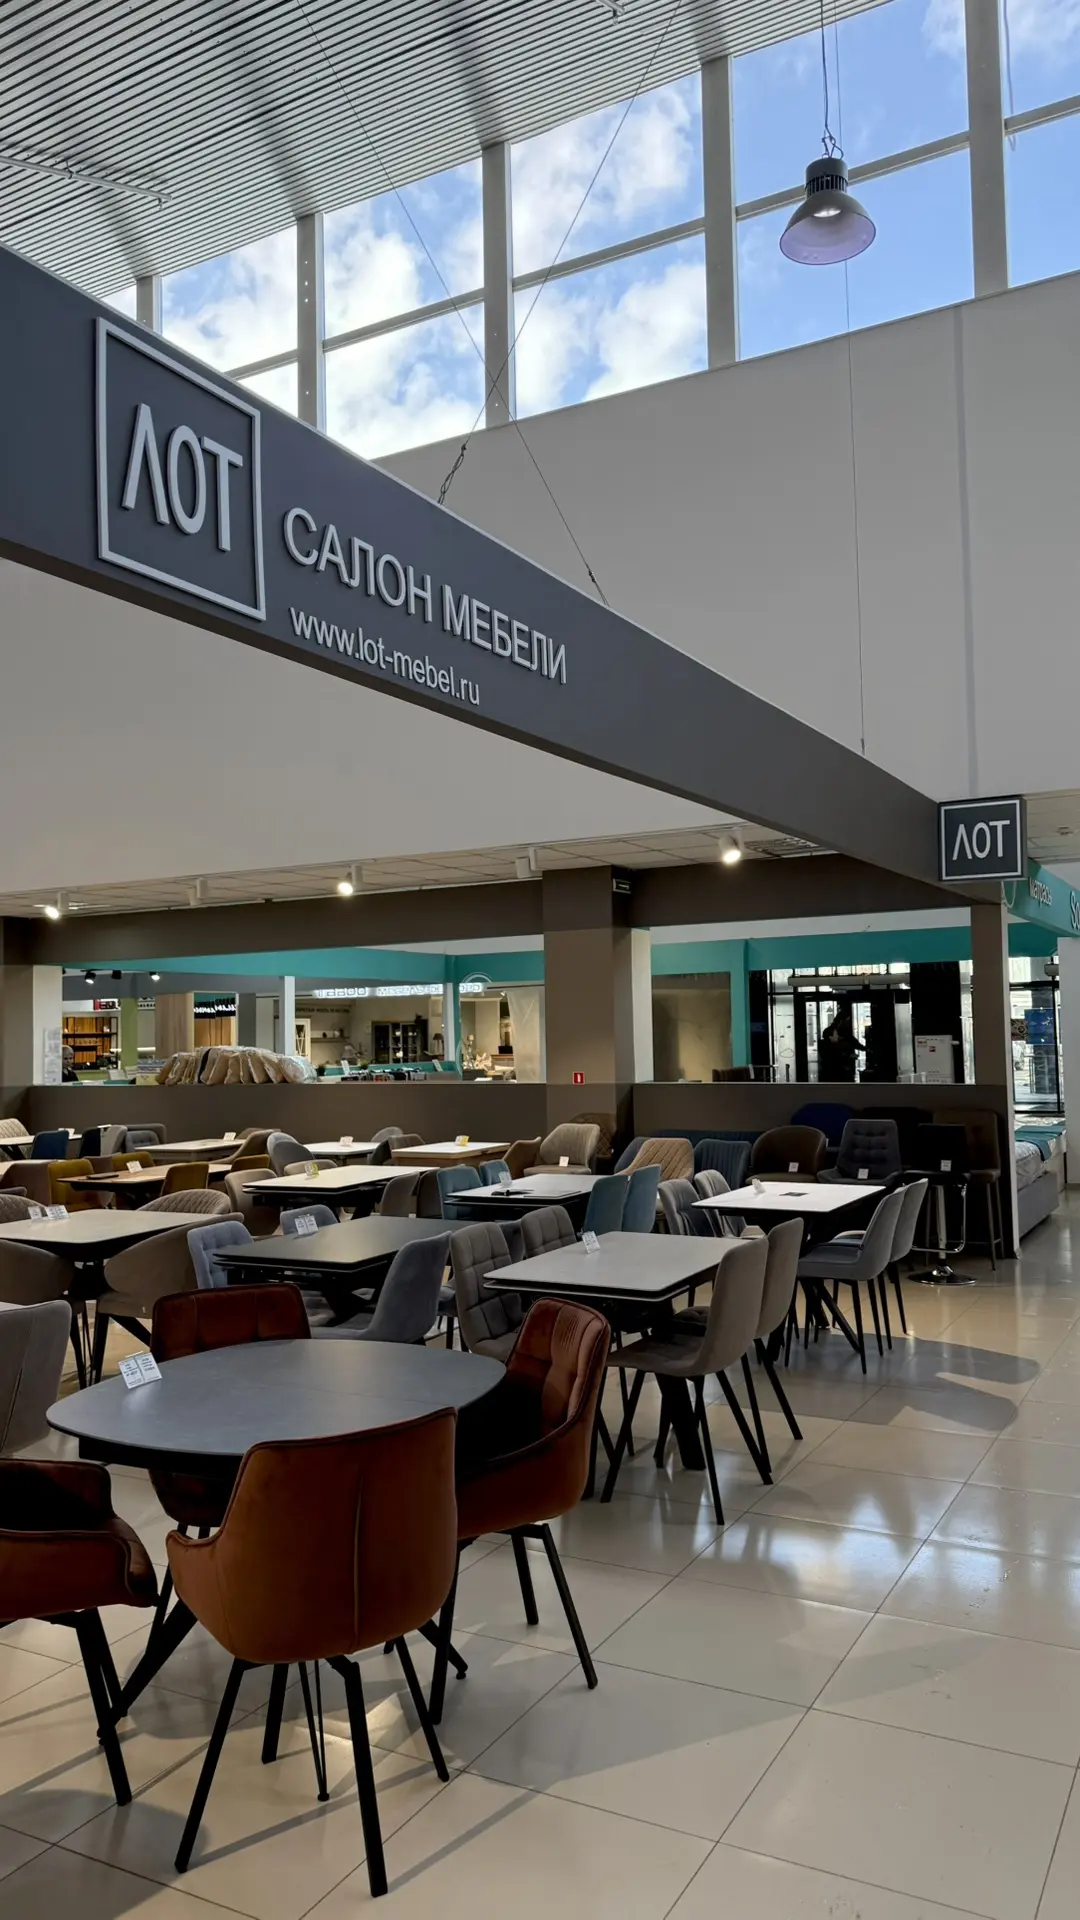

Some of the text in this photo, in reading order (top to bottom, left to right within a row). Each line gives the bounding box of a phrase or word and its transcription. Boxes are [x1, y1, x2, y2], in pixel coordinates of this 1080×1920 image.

[121, 403, 244, 552] ЛОТ
[282, 507, 568, 685] САЛОН МЕБЕЛИ
[288, 606, 481, 706] www.lot-mebel.ru
[952, 820, 1011, 861] ЛОТ
